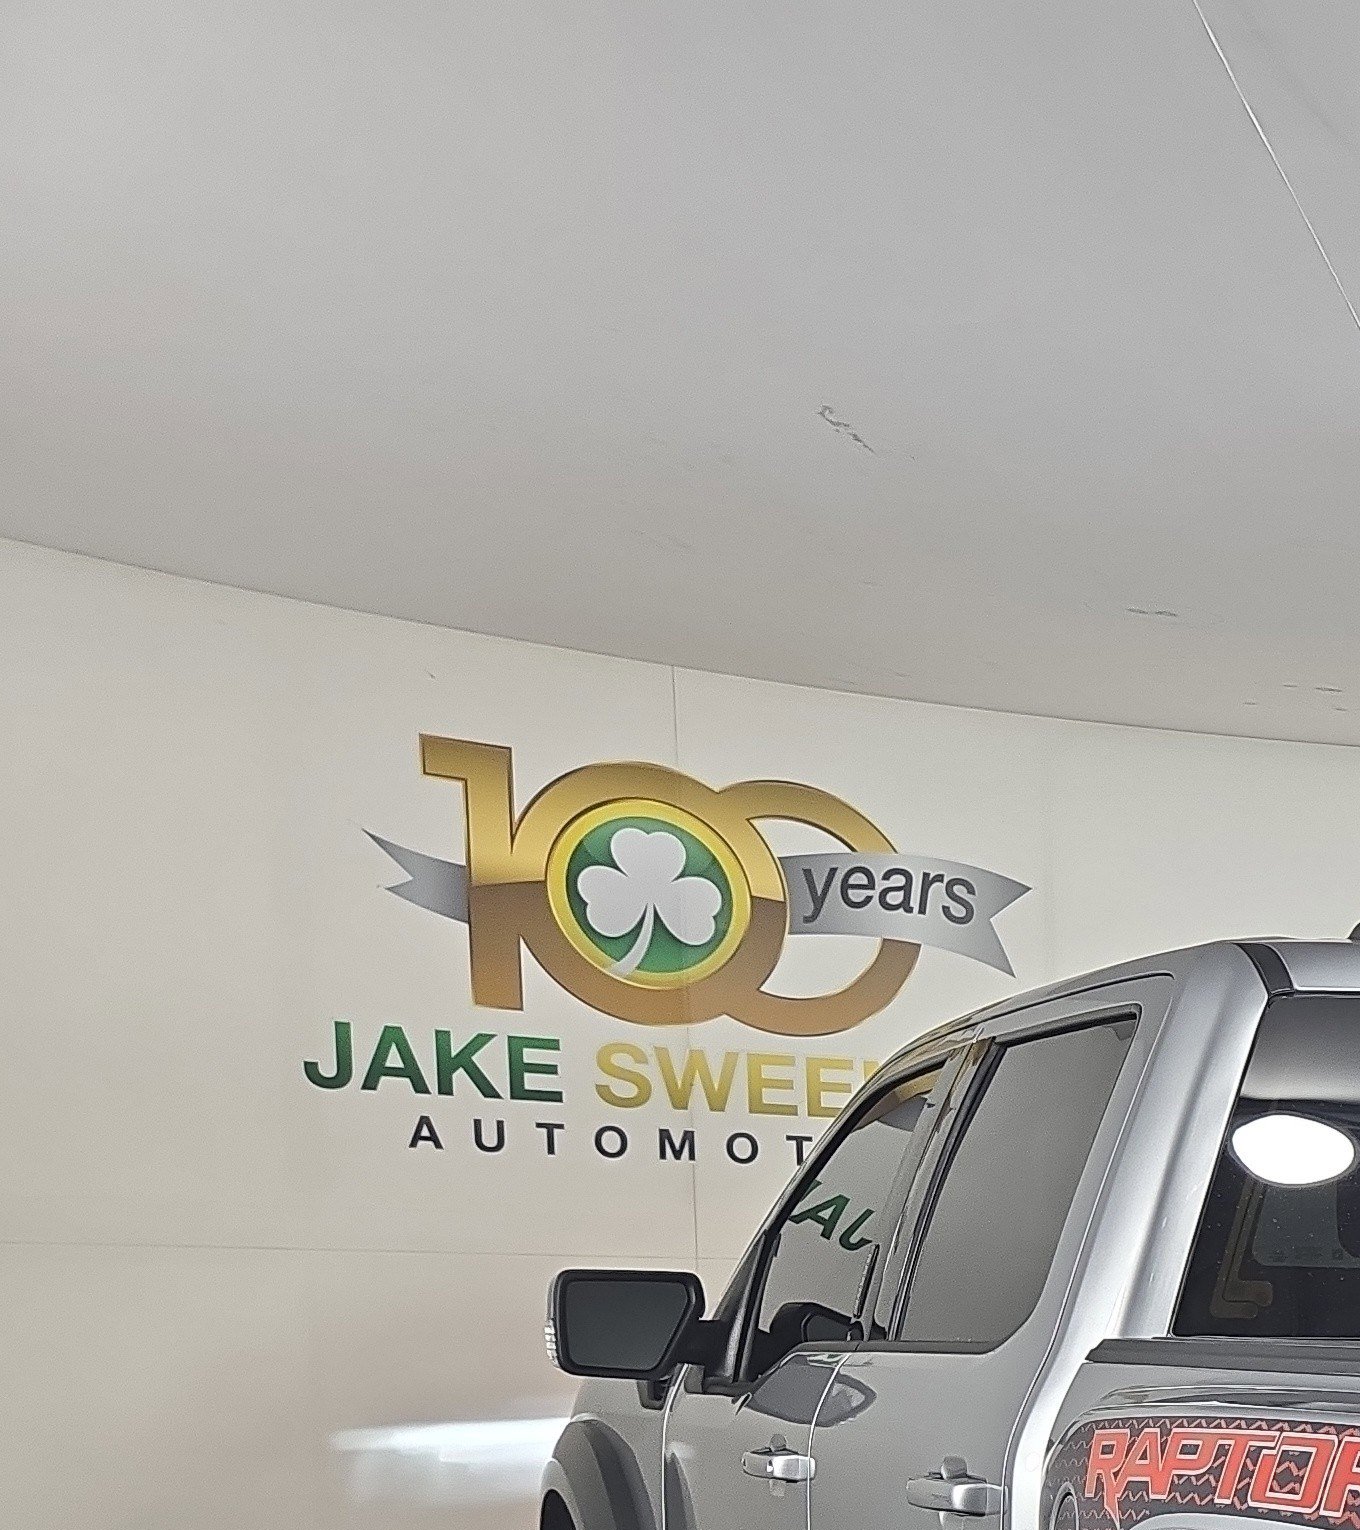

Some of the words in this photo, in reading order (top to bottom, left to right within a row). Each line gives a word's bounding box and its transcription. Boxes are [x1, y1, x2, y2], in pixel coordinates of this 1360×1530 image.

[803, 866, 978, 925] years
[304, 1021, 563, 1104] JAKE
[594, 1042, 880, 1118] SWEE
[408, 1115, 813, 1167] AUTOMOT
